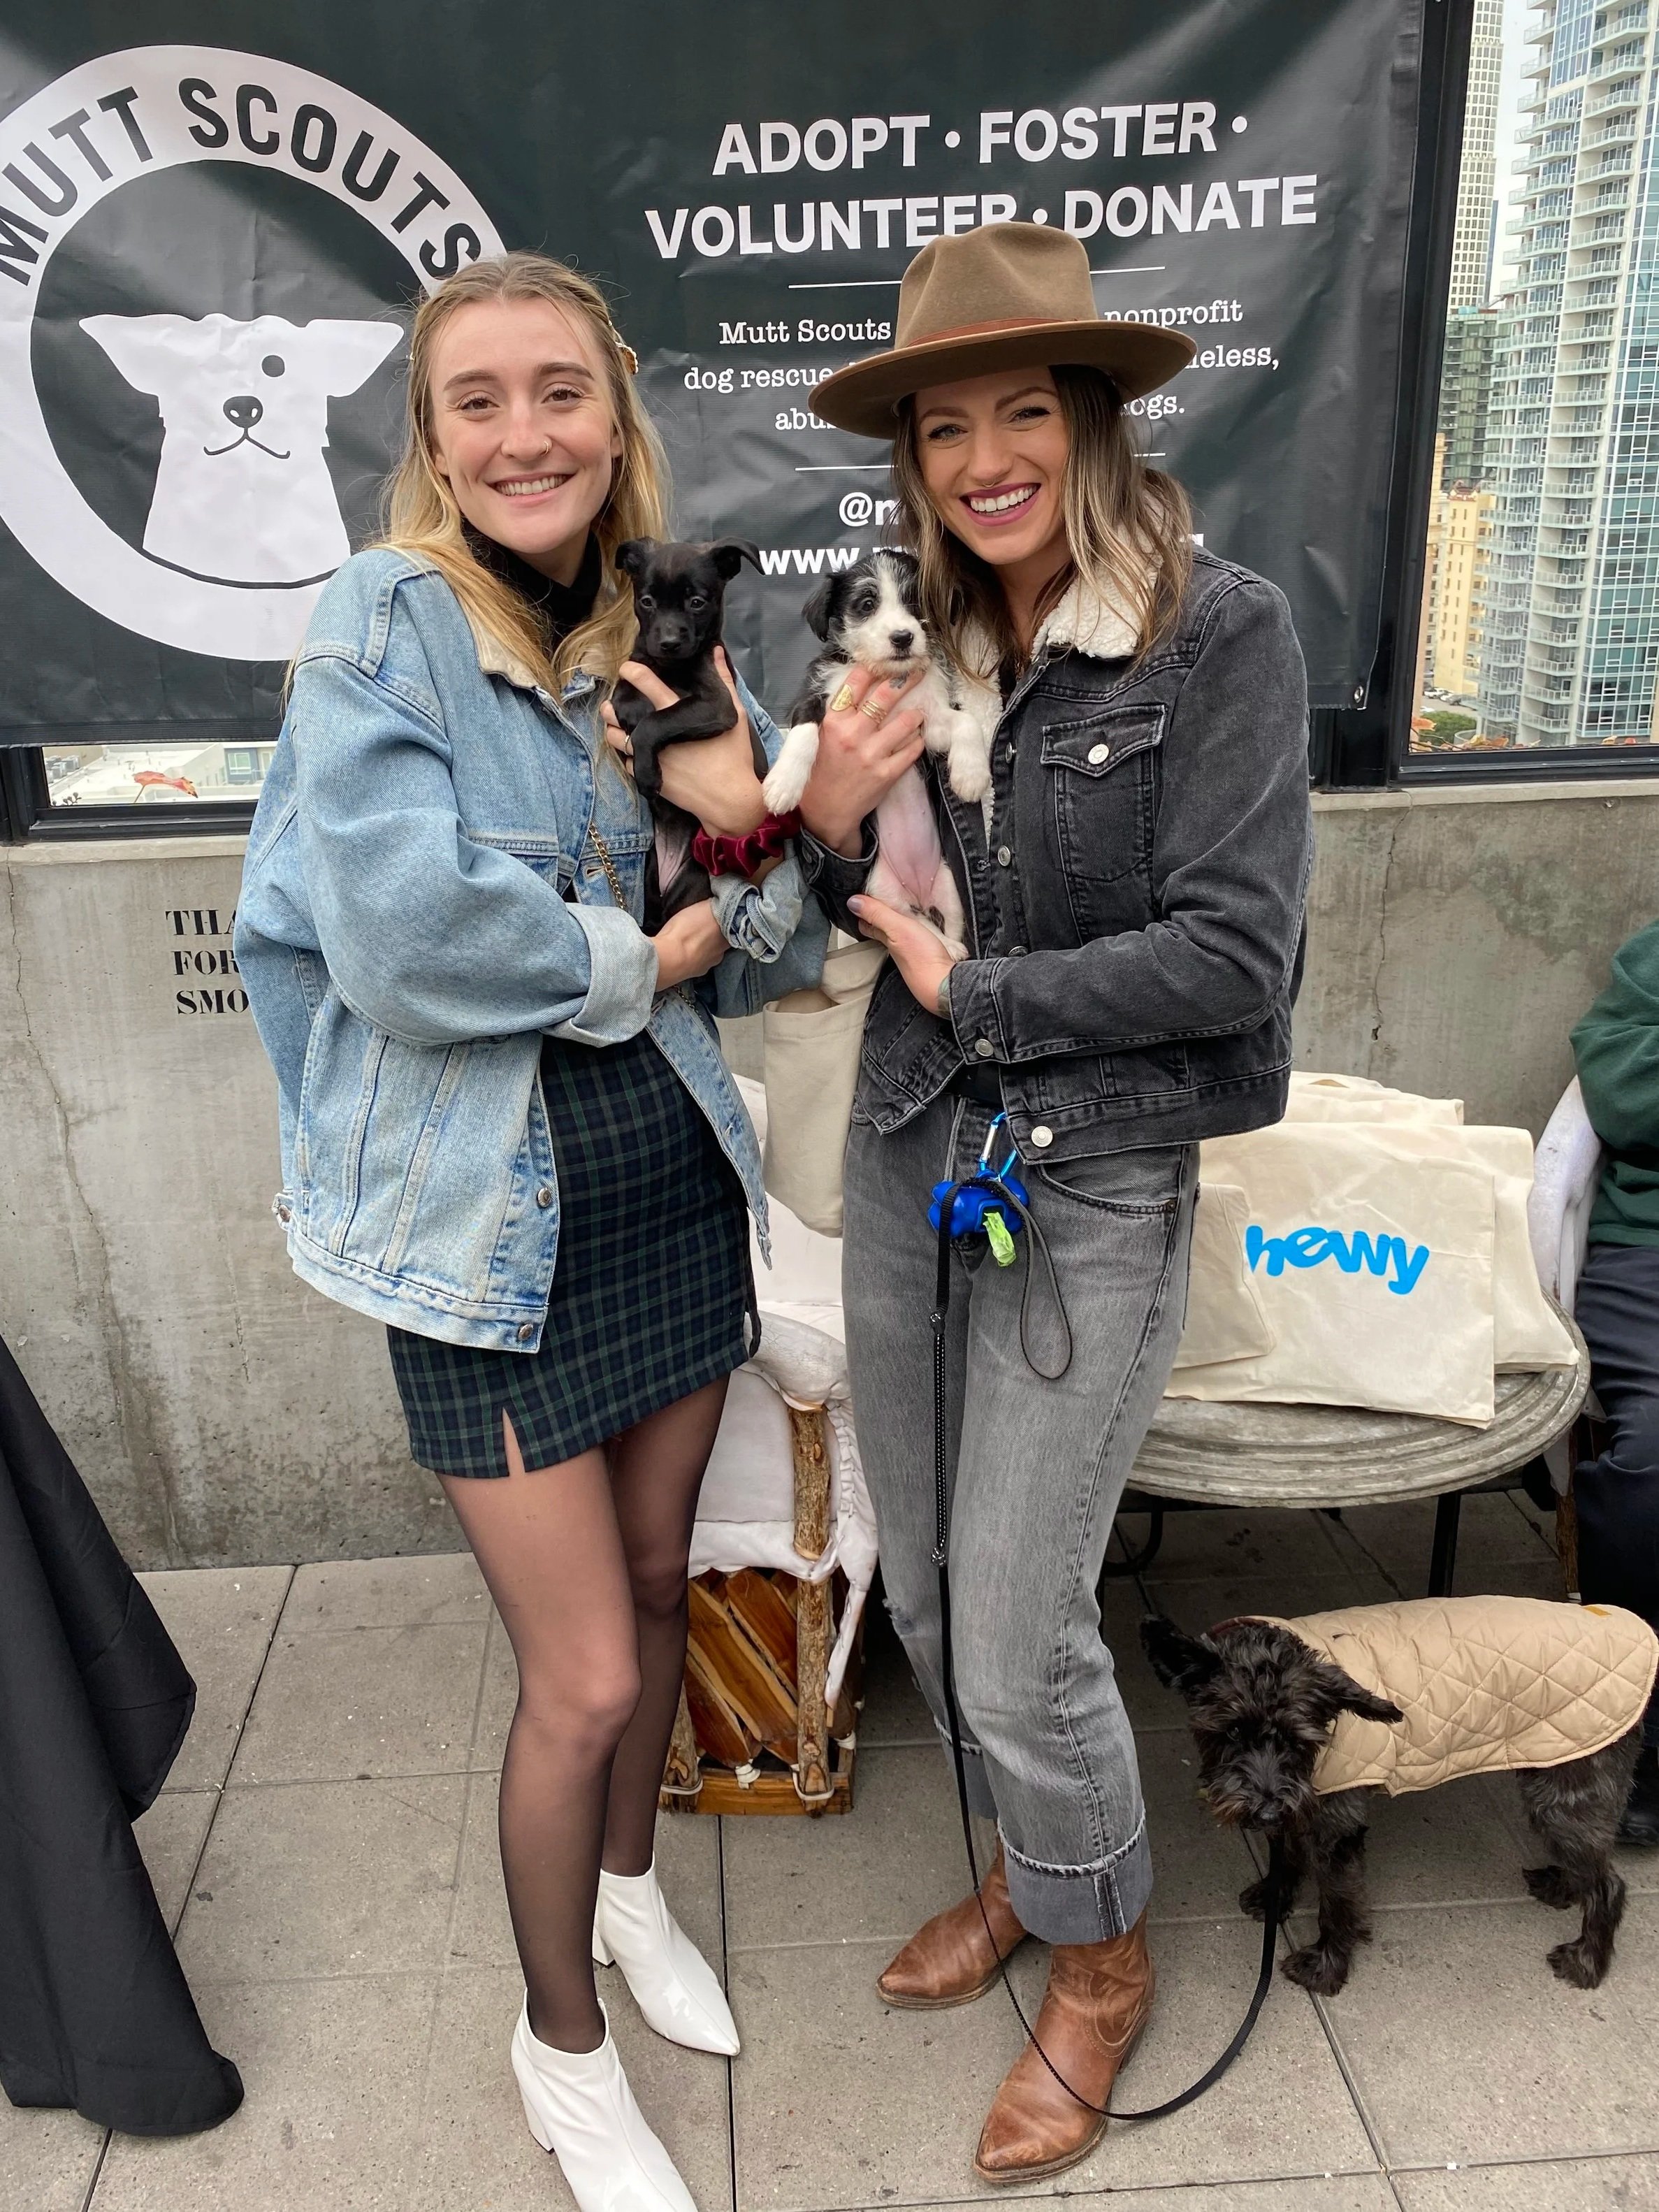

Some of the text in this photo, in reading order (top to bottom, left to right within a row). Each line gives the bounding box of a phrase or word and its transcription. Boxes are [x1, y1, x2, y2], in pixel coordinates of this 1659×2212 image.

[711, 101, 1217, 175] ADOPT FOSTER
[0, 78, 481, 287] MUTT SCOUTS
[644, 174, 1318, 259] VOLUNTEER DONATE
[718, 299, 1244, 345] Mutt Scouts nonprofit
[683, 367, 734, 393] dog
[740, 367, 834, 388] rescue
[1120, 394, 1186, 420] ogs.
[171, 950, 240, 976] FOR
[175, 988, 249, 1015] SMO
